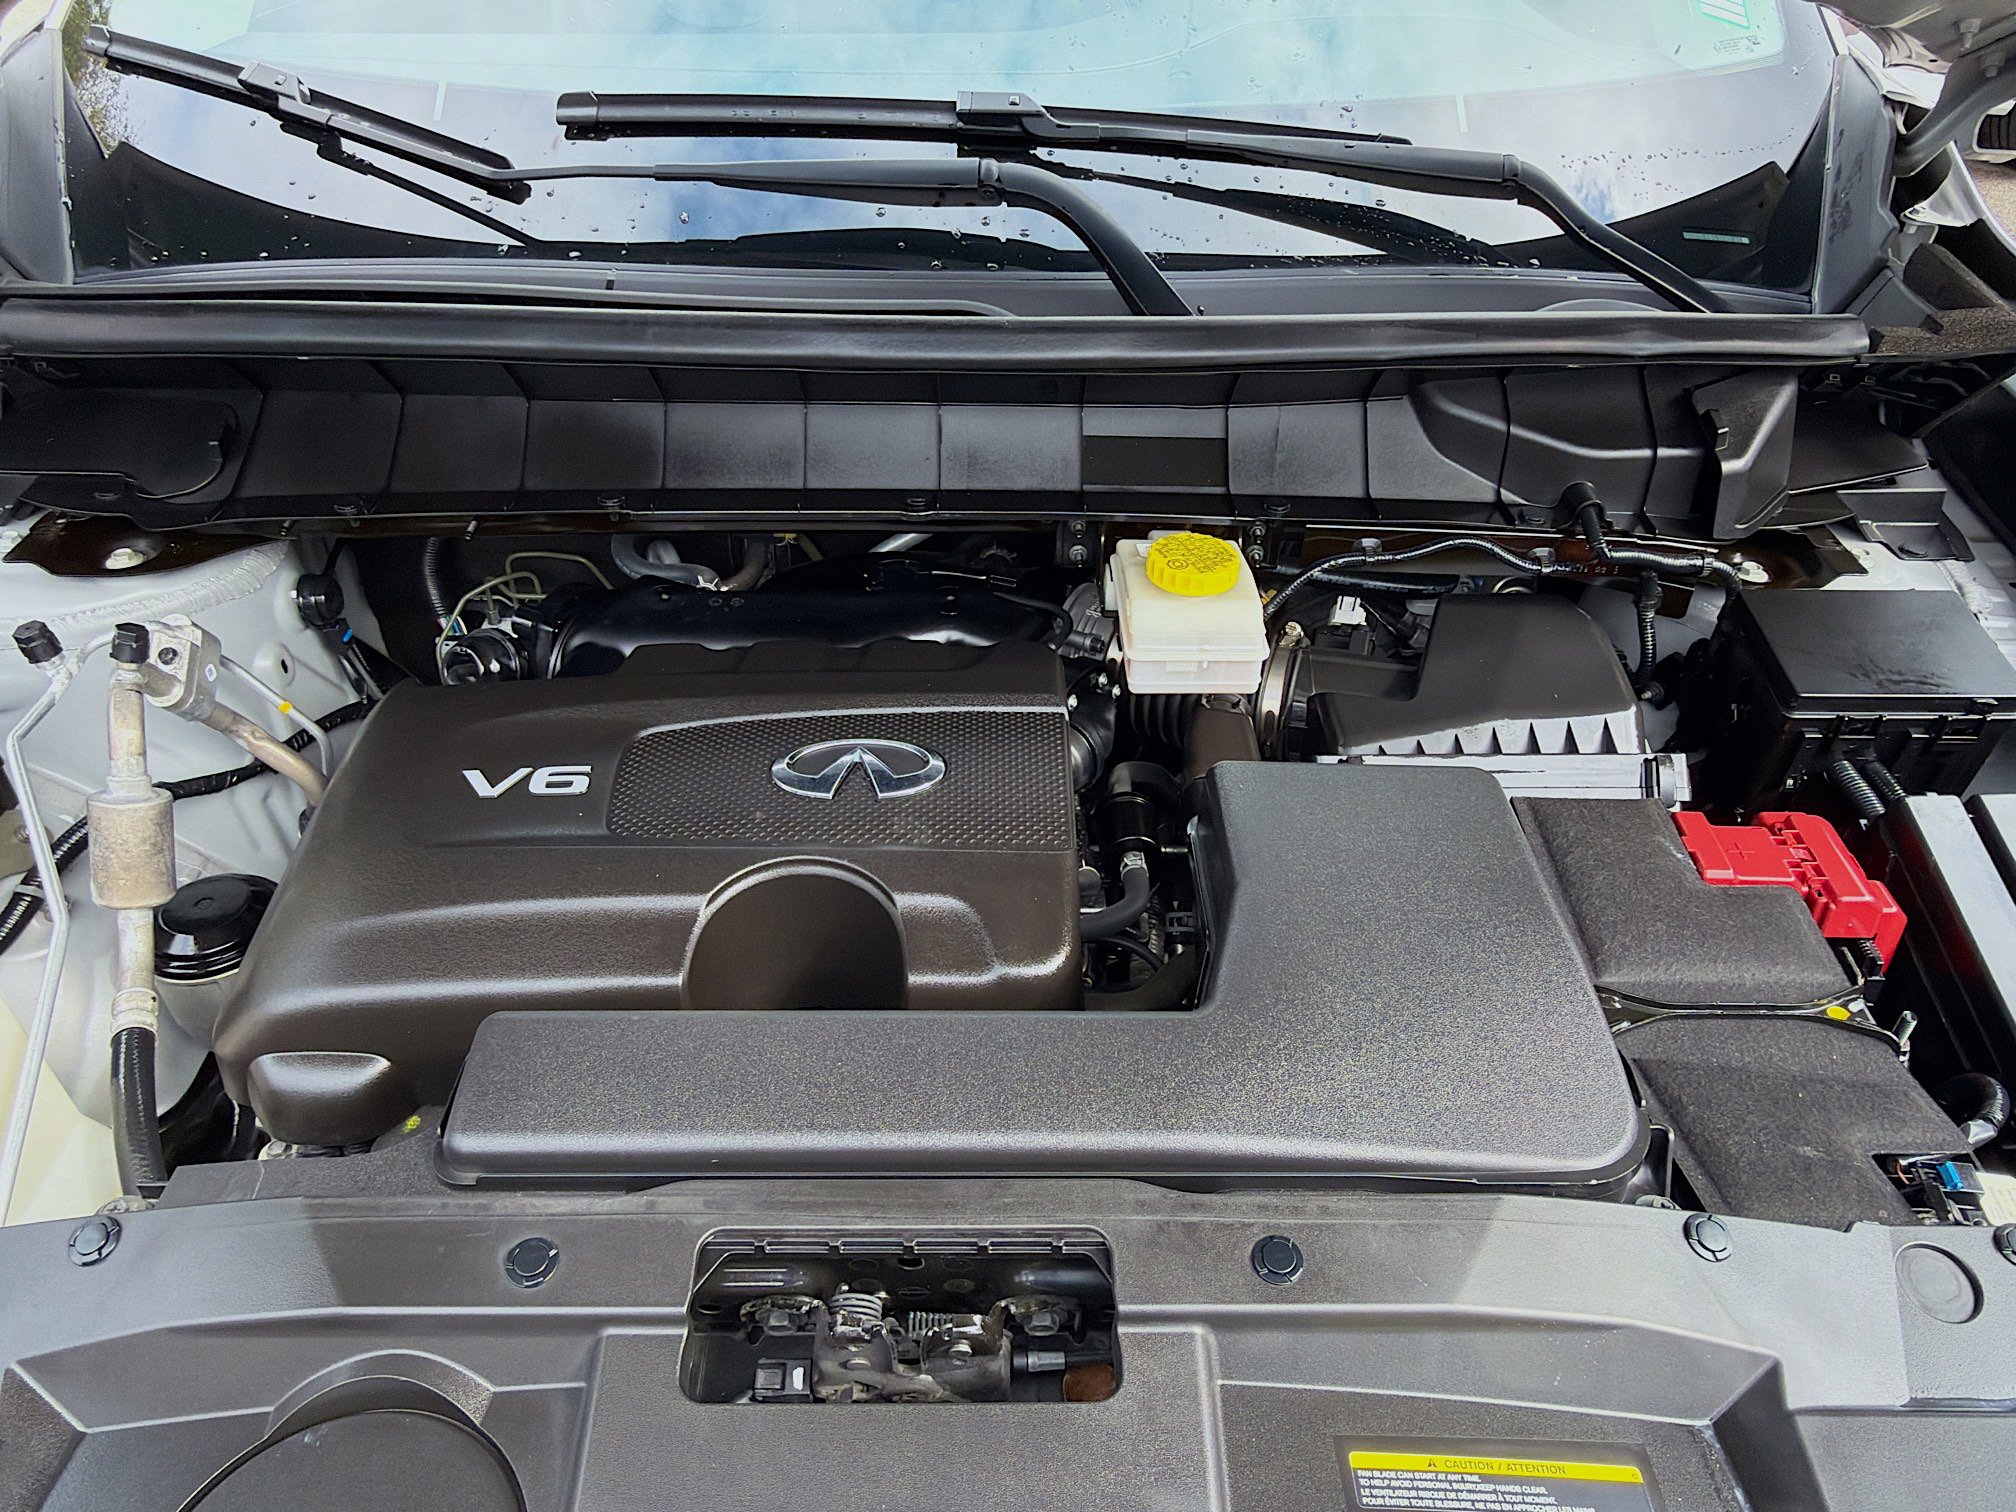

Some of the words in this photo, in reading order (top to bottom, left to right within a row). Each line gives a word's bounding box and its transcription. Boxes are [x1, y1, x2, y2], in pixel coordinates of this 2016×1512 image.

[462, 764, 593, 799] V6
[1444, 1459, 1494, 1471] CAUTION
[1506, 1463, 1567, 1475] ATTENTION
[1357, 1469, 1372, 1478] FAN
[1373, 1470, 1397, 1479] BLADE
[1397, 1471, 1413, 1479] CAN
[1414, 1472, 1436, 1480] START
[1447, 1473, 1462, 1481] ANY
[1359, 1478, 1370, 1486] TO
[1371, 1479, 1390, 1487] HELP
[1391, 1480, 1413, 1488] AVOID
[1413, 1481, 1452, 1490] PERSONAL
[1496, 1484, 1522, 1493] HANDS
[1360, 1488, 1371, 1496] LE
[1371, 1489, 1418, 1498] VENTILATEUR
[1505, 1494, 1524, 1502] TOUT
[1362, 1497, 1384, 1506] POUR
[1411, 1499, 1435, 1508] TOUTE
